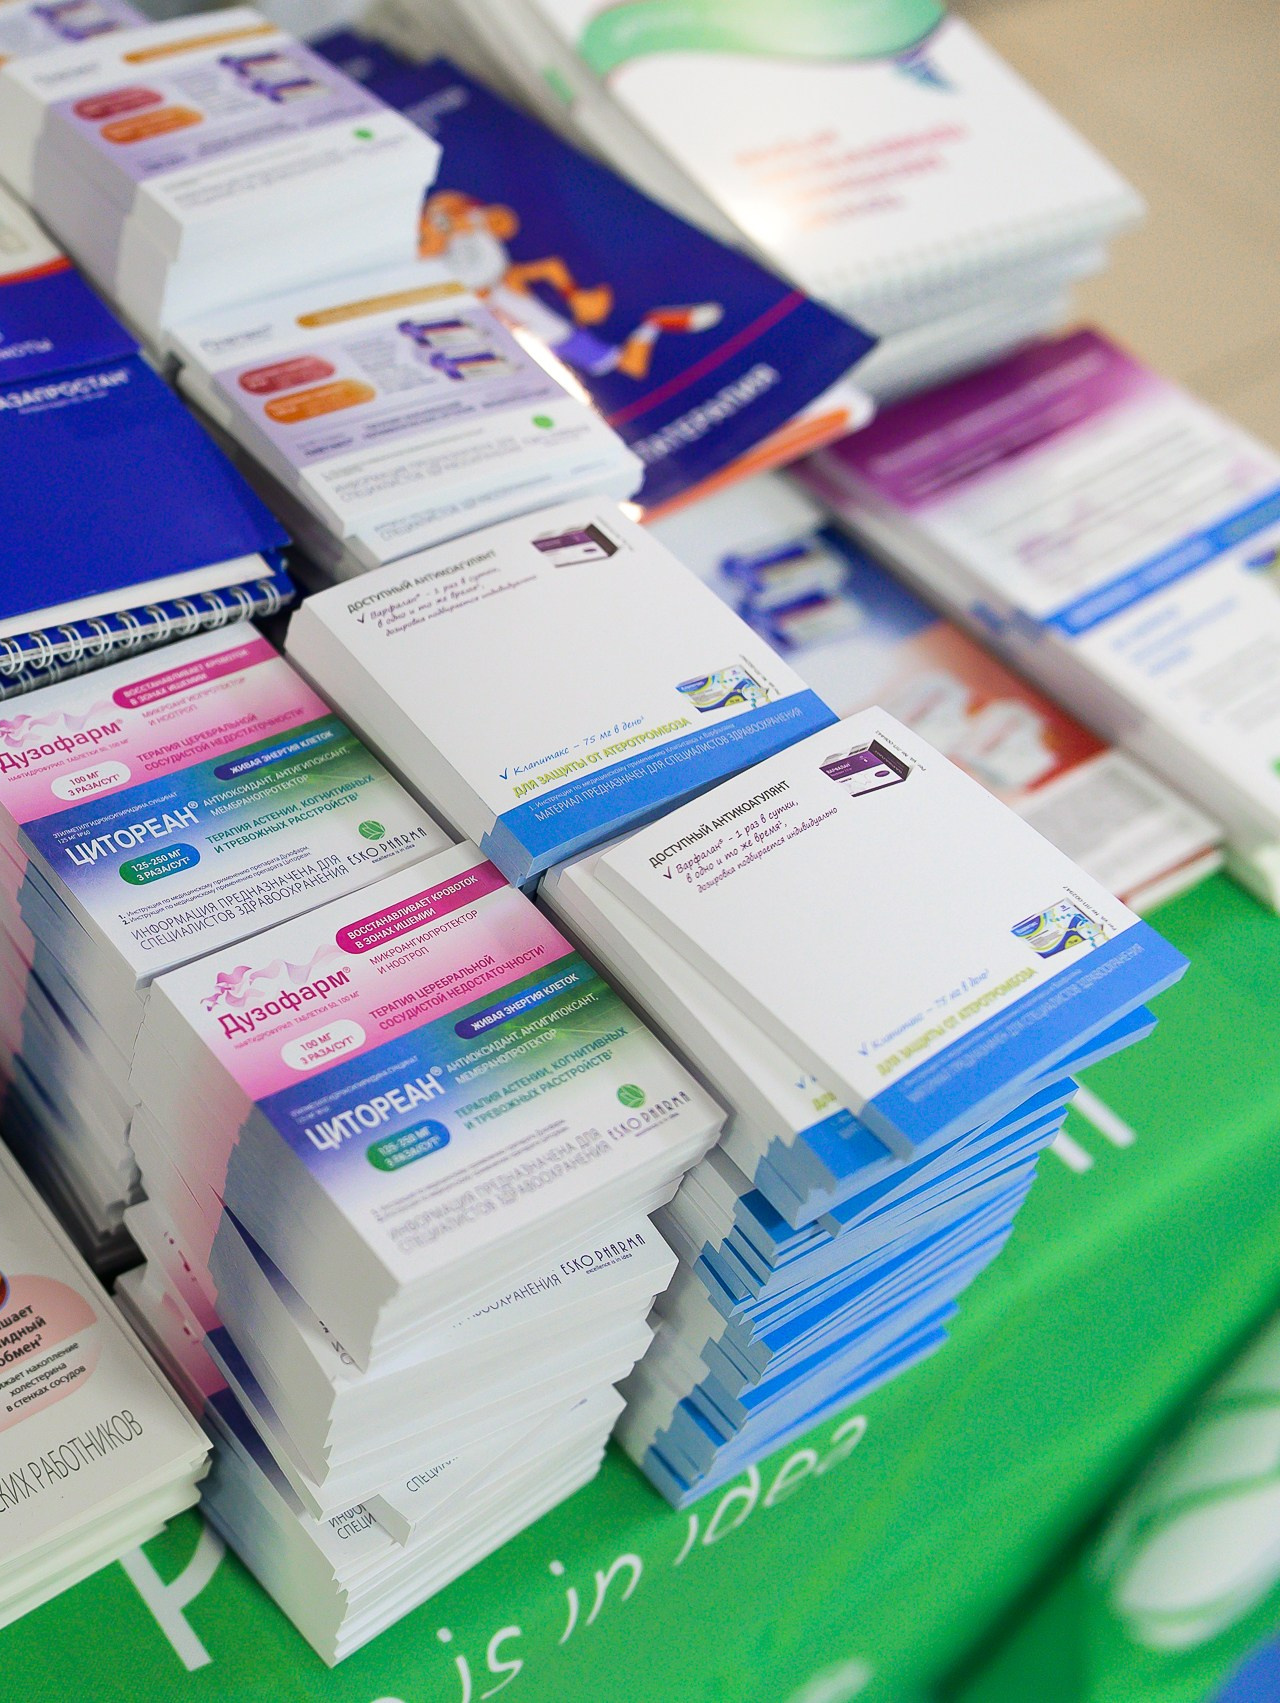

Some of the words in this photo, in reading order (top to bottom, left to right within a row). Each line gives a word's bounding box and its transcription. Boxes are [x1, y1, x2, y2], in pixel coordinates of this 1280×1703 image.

[134, 740, 182, 762] ТЕРАПИЯ
[179, 712, 258, 747] ЦЕРЕБРАЛЬНОЙ
[511, 778, 540, 799] ДЛЯ
[535, 756, 589, 785] ЗАЩИТЫ
[584, 750, 603, 764] ОТ
[601, 716, 692, 758] АТЕРОТРОМБОЗА
[533, 793, 584, 822] МАТЕРИАЛ
[579, 766, 648, 801] ПРЕДНАЗНАЧЕН
[645, 759, 667, 776] ДЛЯ
[662, 734, 730, 767] СПЕЦИАЛИСТОВ
[725, 706, 803, 741] ЗДРАВООХРАНЕНИЯ
[68, 774, 87, 786] 100
[85, 769, 99, 780] МГ
[202, 773, 276, 807] АНТИОКСИДАНТ,
[274, 745, 347, 780] АНТИГИПОКСАНТ,
[203, 820, 253, 844] ТЕРАПИЯ
[251, 803, 302, 828] АСТЕНИИ,
[299, 774, 374, 809] КОГНИТИВНЫХ
[221, 819, 289, 850] ТРЕВОЖНЫХ
[647, 823, 714, 869] ДОСТУПНЫЙ
[710, 779, 790, 830] АНТИКОАГУЛЯНТ
[129, 853, 169, 872] 125-250
[166, 847, 181, 859] МГ
[345, 846, 379, 866] ESKO
[377, 826, 428, 853] PHARMA
[129, 901, 219, 944] ИНФОРМАЦИЯ
[215, 863, 318, 909] ПРЕДНАЗНАЧЕНА
[315, 853, 342, 873] ДЛЯ
[139, 908, 236, 951] СПЕЦИАЛИСТОВ
[233, 863, 350, 916] ЗДРАВООХРАНЕНИЯ
[345, 895, 432, 940] ВОССТАНАВЛИВАЕТ
[429, 874, 479, 902] КРОВОТОК
[361, 925, 396, 945] ЗОНАХ
[392, 906, 437, 932] ИШЕМИИ
[368, 908, 478, 966] МИКРОАНГИОПРОТЕКТОР
[383, 945, 430, 971] НООТРОП
[367, 992, 417, 1019] ТЕРАПИЯ
[413, 953, 496, 999] ЦЕРЕБРАЛЬНОЙ
[377, 990, 449, 1030] СОСУДИСТОЙ
[469, 1009, 506, 1031] ЖИВАЯ
[502, 989, 546, 1015] ЭНЕРГИЯ
[541, 971, 580, 996] КЛЕТОК
[560, 1254, 594, 1276] ESKO
[594, 1233, 646, 1262] PHARMA
[8, 1361, 68, 1397] холестерина
[12, 1384, 50, 1408] стенках
[48, 1364, 87, 1389] сосудов
[25, 1408, 143, 1490] РАБОТНИКОВ
[548, 1552, 644, 1645] in
